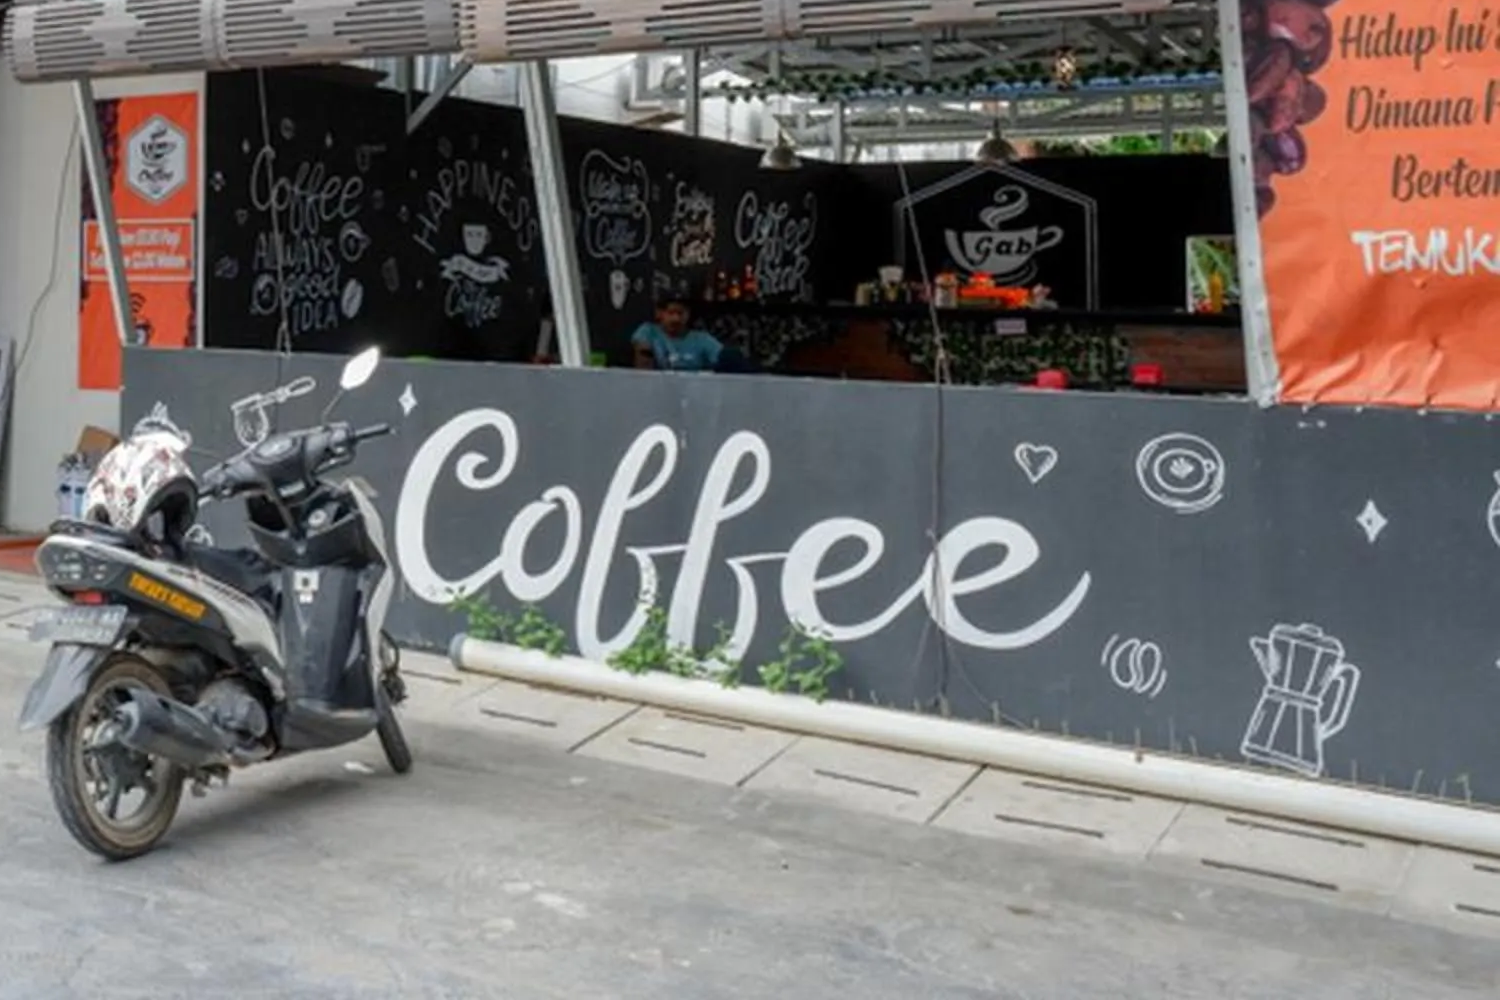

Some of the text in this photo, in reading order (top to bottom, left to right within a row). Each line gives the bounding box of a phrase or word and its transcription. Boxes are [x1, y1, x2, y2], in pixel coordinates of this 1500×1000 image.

[1338, 12, 1436, 72] Hidup
[1445, 7, 1490, 53] Ini
[1346, 85, 1476, 133] Dimana
[251, 145, 364, 236] Coffee
[411, 159, 538, 253] HAPPINESS
[973, 234, 1033, 267] Gab
[1350, 226, 1500, 276] TEMUK
[291, 299, 340, 335] IDEA
[394, 406, 1092, 676] Coffee
